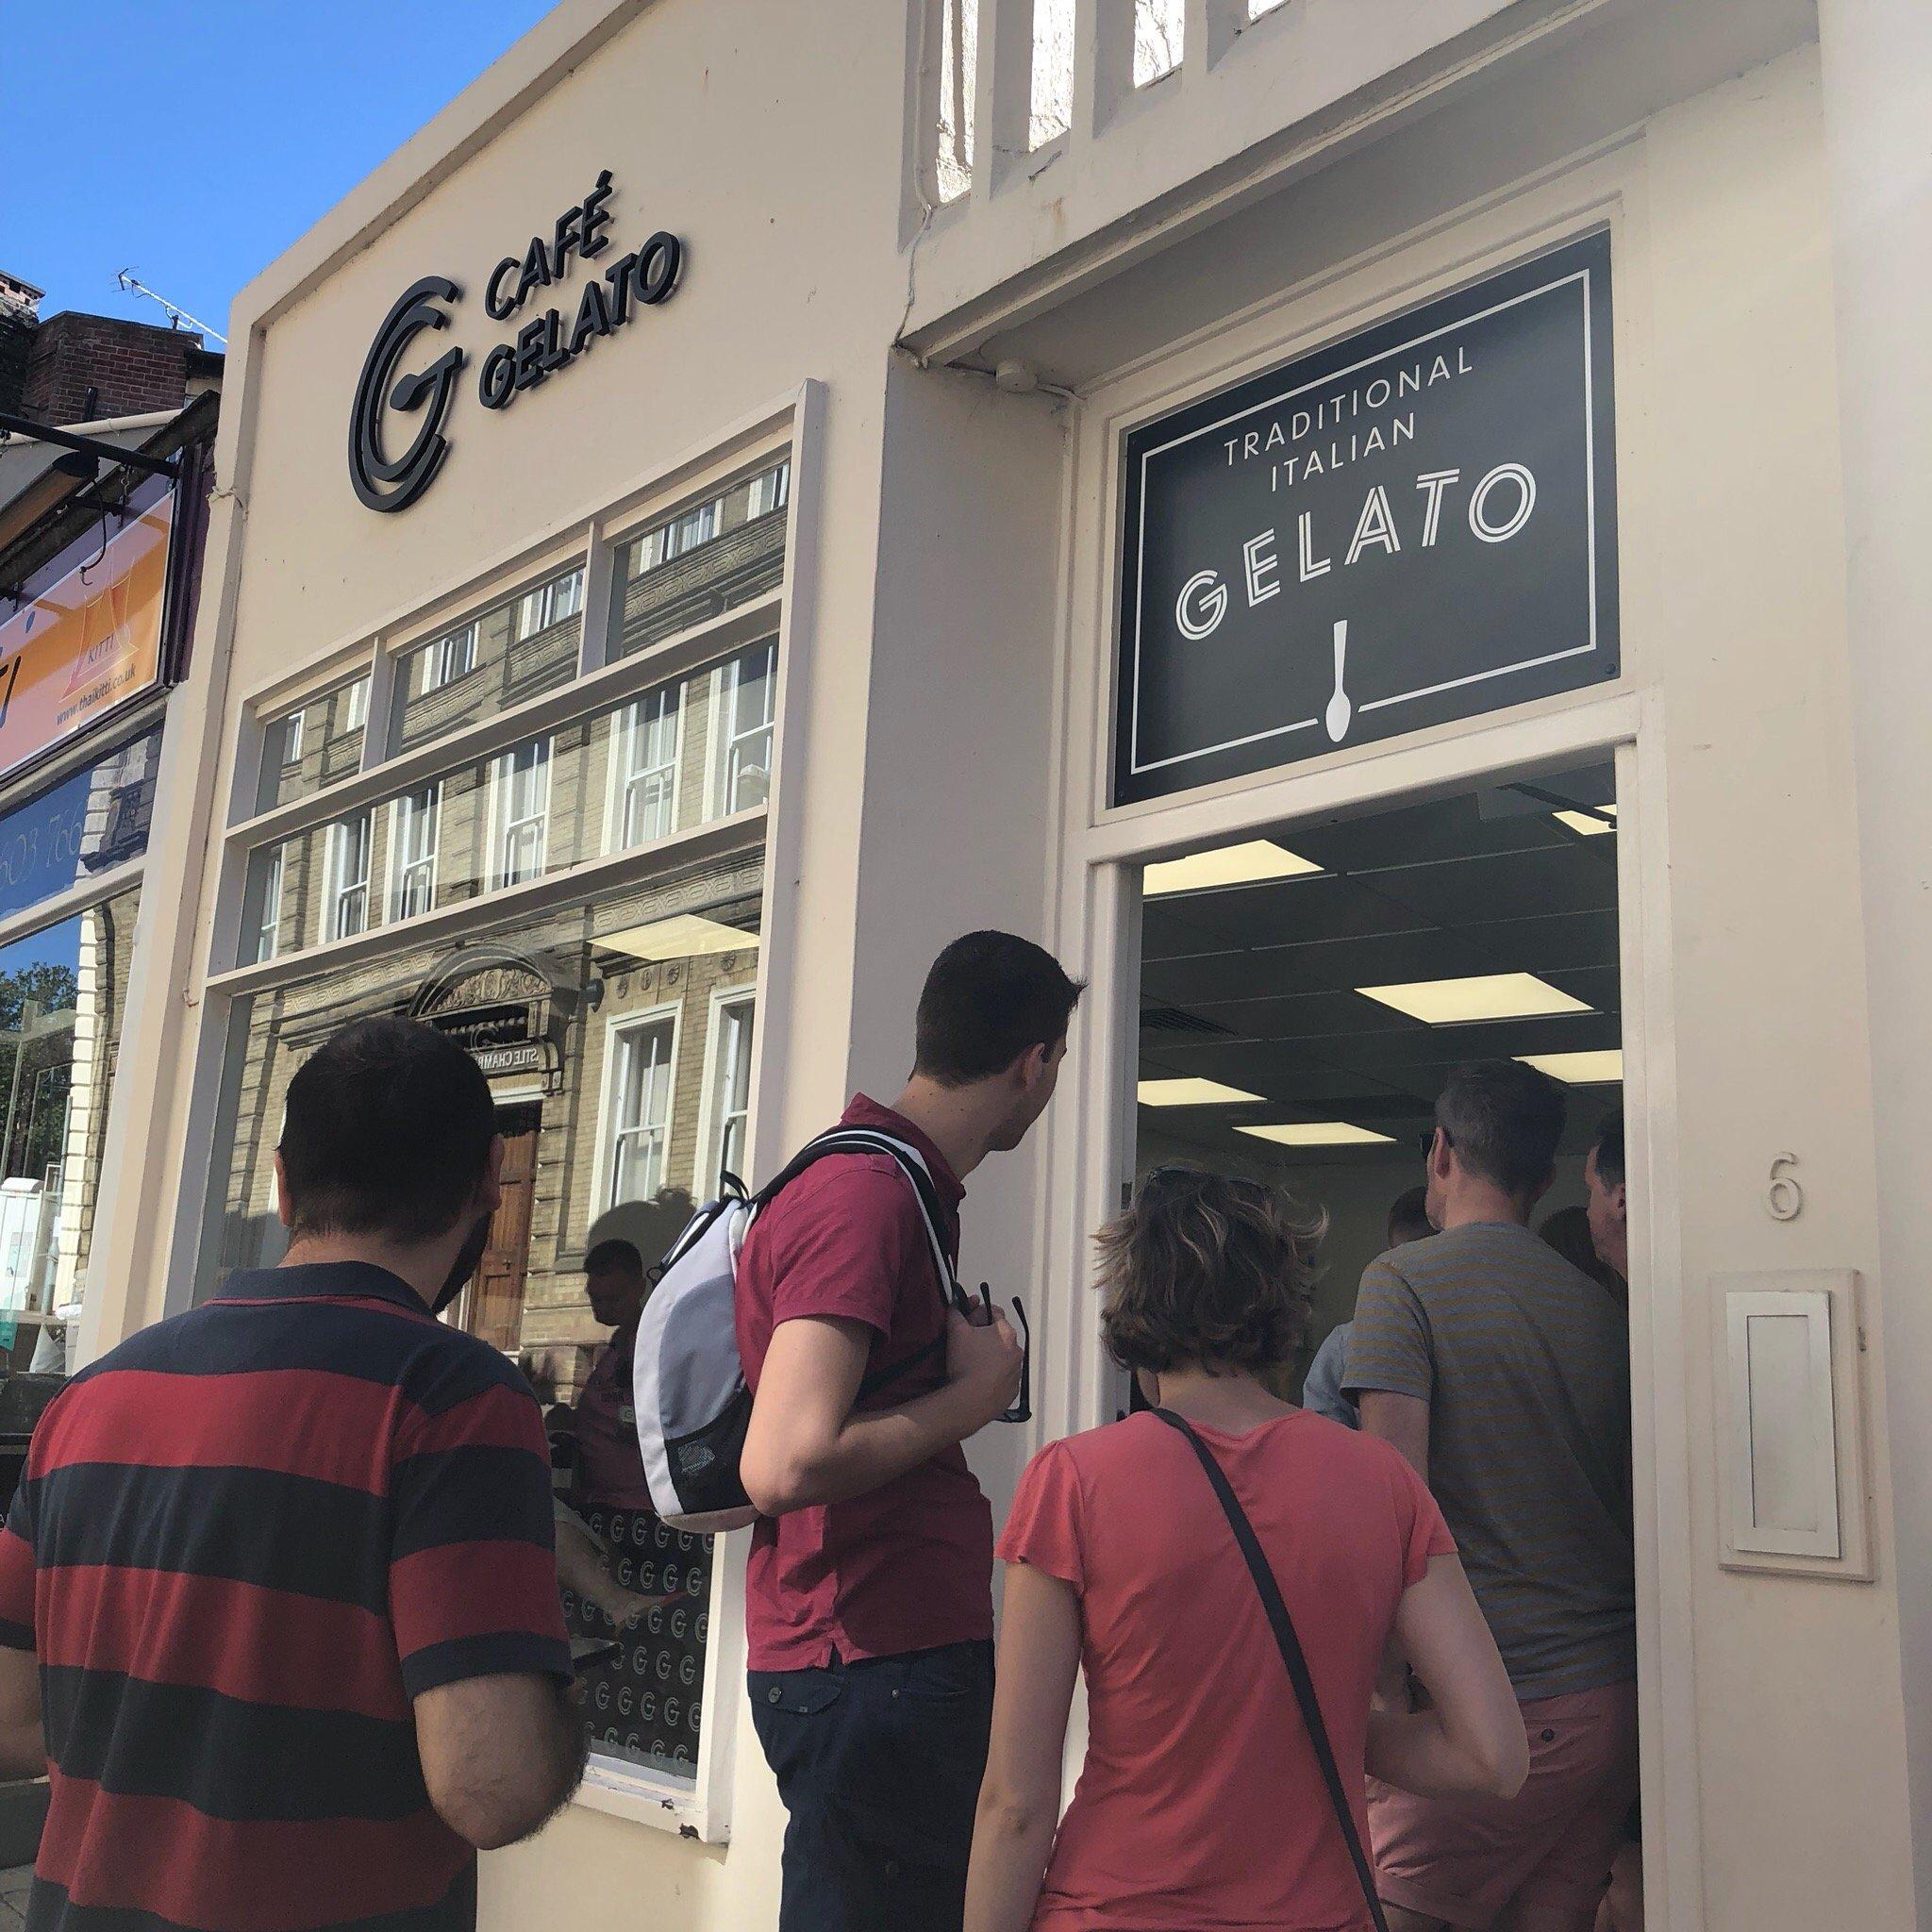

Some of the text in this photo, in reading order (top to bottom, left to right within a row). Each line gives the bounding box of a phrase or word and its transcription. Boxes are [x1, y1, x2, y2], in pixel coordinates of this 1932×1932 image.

[484, 169, 613, 322] CAFÉ
[478, 230, 681, 410] GELATO
[1224, 346, 1474, 467] TRADITIONAL
[1271, 411, 1416, 492] ITALIAN
[1174, 462, 1537, 641] GELATO
[57, 662, 136, 725] www.thaikitti.co.uk
[87, 632, 115, 664] KITTI
[1767, 1150, 1804, 1223] 6
